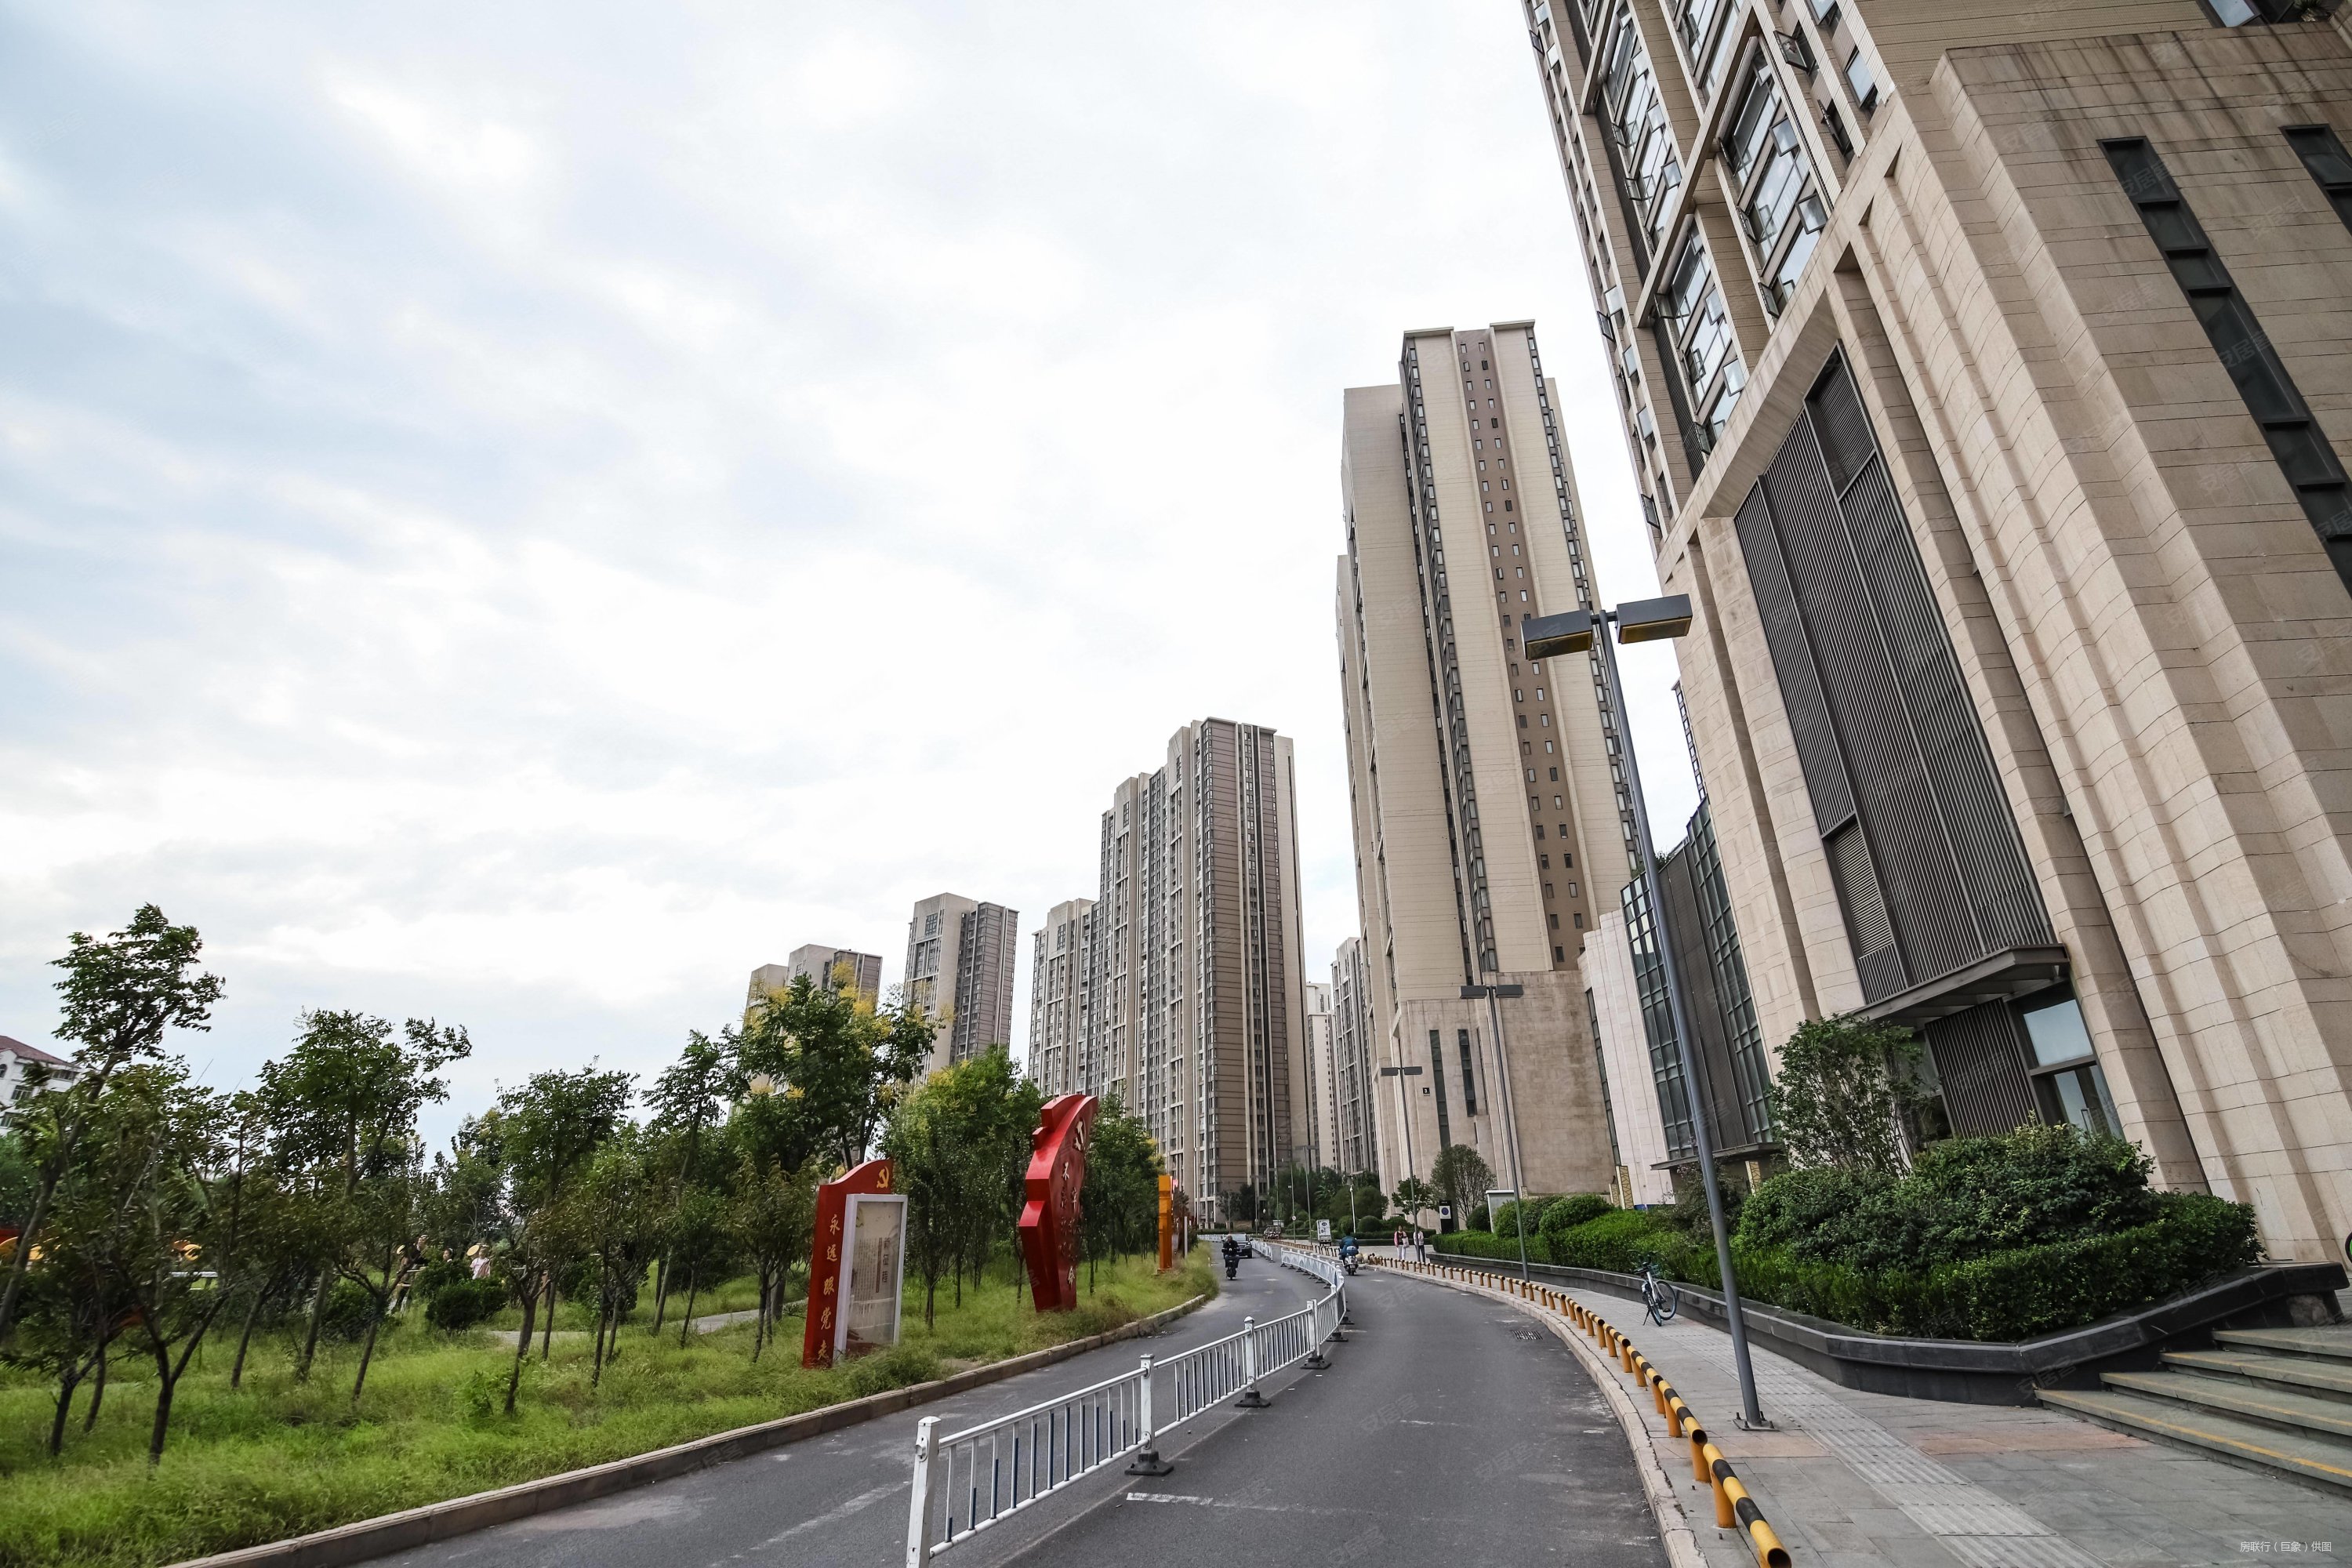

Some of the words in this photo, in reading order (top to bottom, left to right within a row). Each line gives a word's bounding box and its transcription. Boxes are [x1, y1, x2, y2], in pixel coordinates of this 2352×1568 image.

[818, 1214, 840, 1360] 永远跟党走
